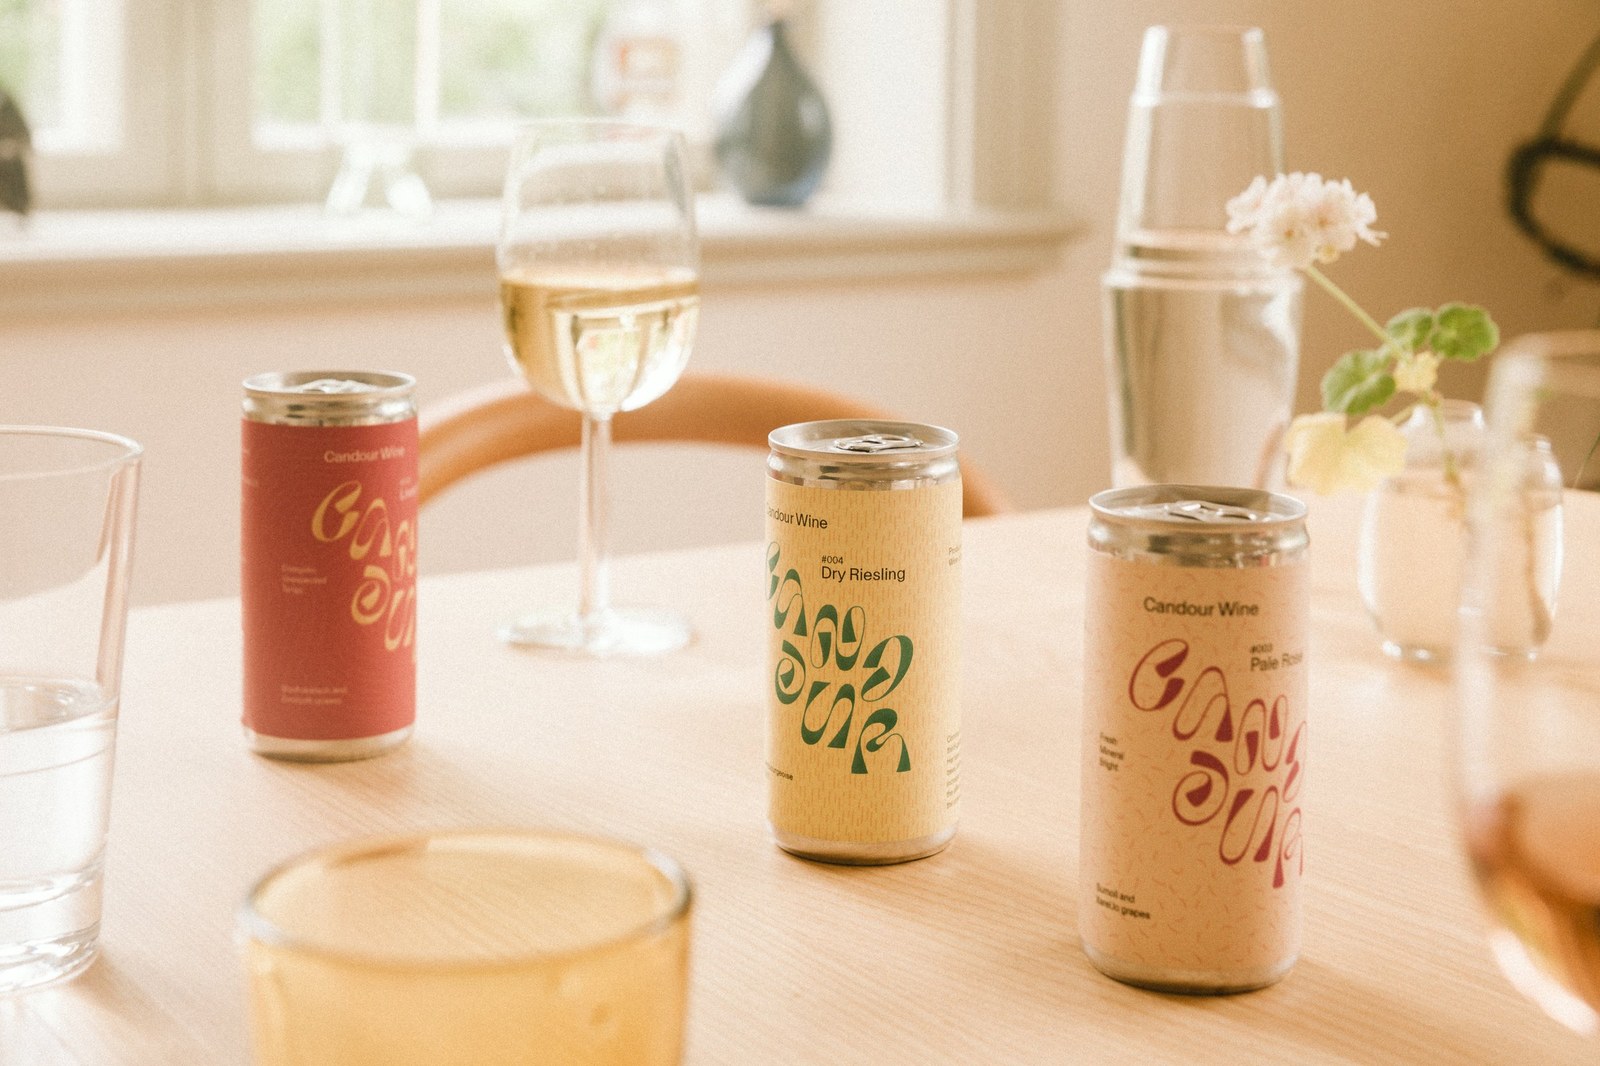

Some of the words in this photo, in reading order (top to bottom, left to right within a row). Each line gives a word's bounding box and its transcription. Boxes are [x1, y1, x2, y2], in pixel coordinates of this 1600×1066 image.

[324, 449, 379, 463] Candour
[767, 502, 794, 524] andour
[795, 512, 828, 529] Wine
[822, 555, 843, 565] #004
[822, 566, 846, 583] Dry
[850, 567, 906, 582] Riesling
[1143, 596, 1214, 616] Candour
[1218, 600, 1259, 616] Wine
[1251, 656, 1279, 671] Pale
